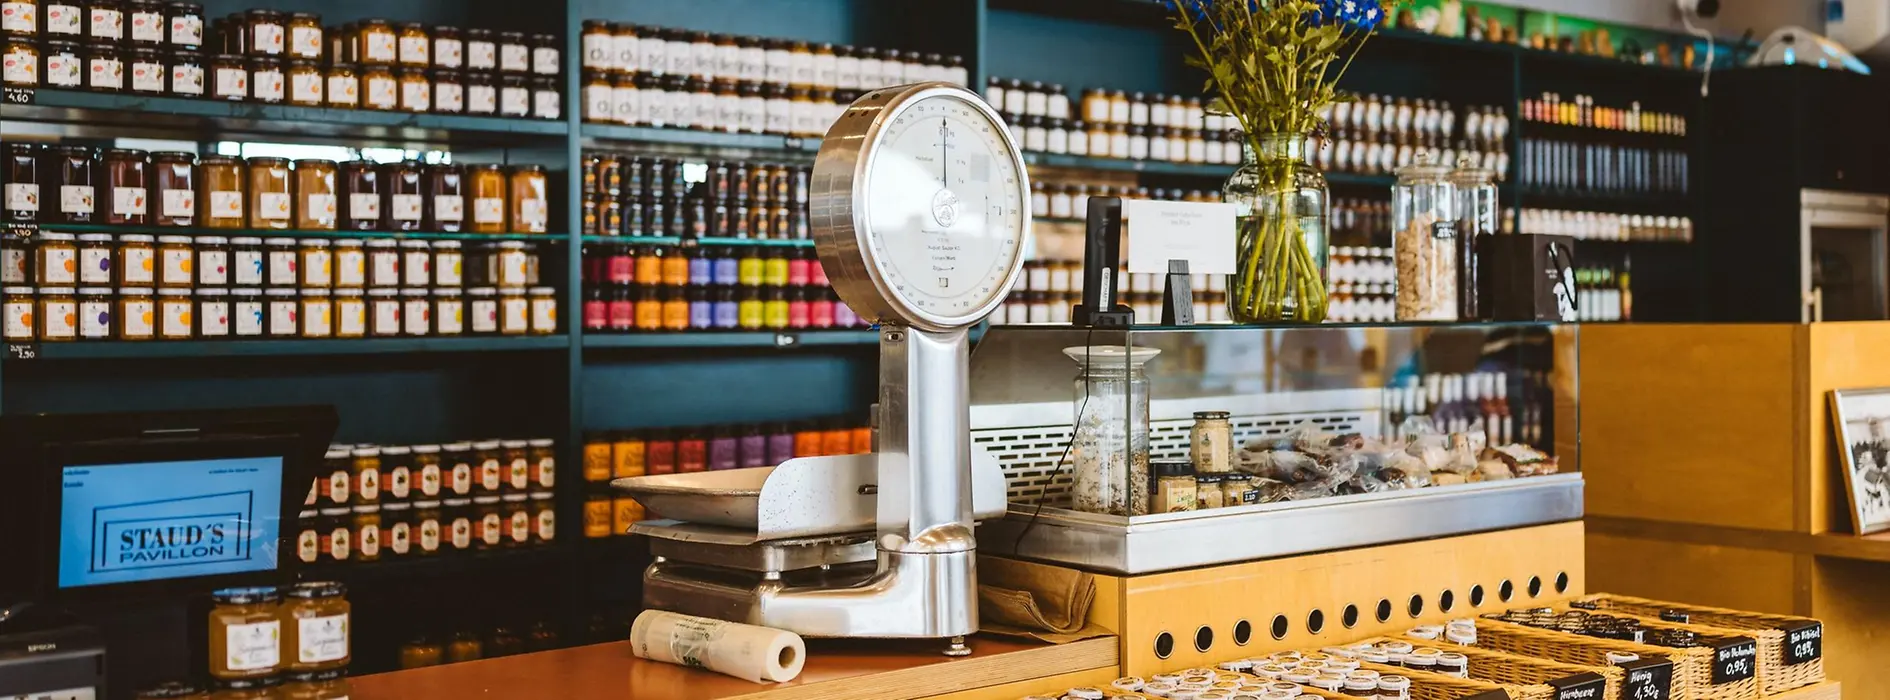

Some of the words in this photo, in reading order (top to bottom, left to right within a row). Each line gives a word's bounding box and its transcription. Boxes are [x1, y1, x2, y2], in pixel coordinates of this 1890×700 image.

[120, 545, 224, 563] PAVILLON
[1791, 632, 1801, 644] Bio
[1719, 649, 1731, 662] Bio
[1630, 671, 1652, 685] Honig
